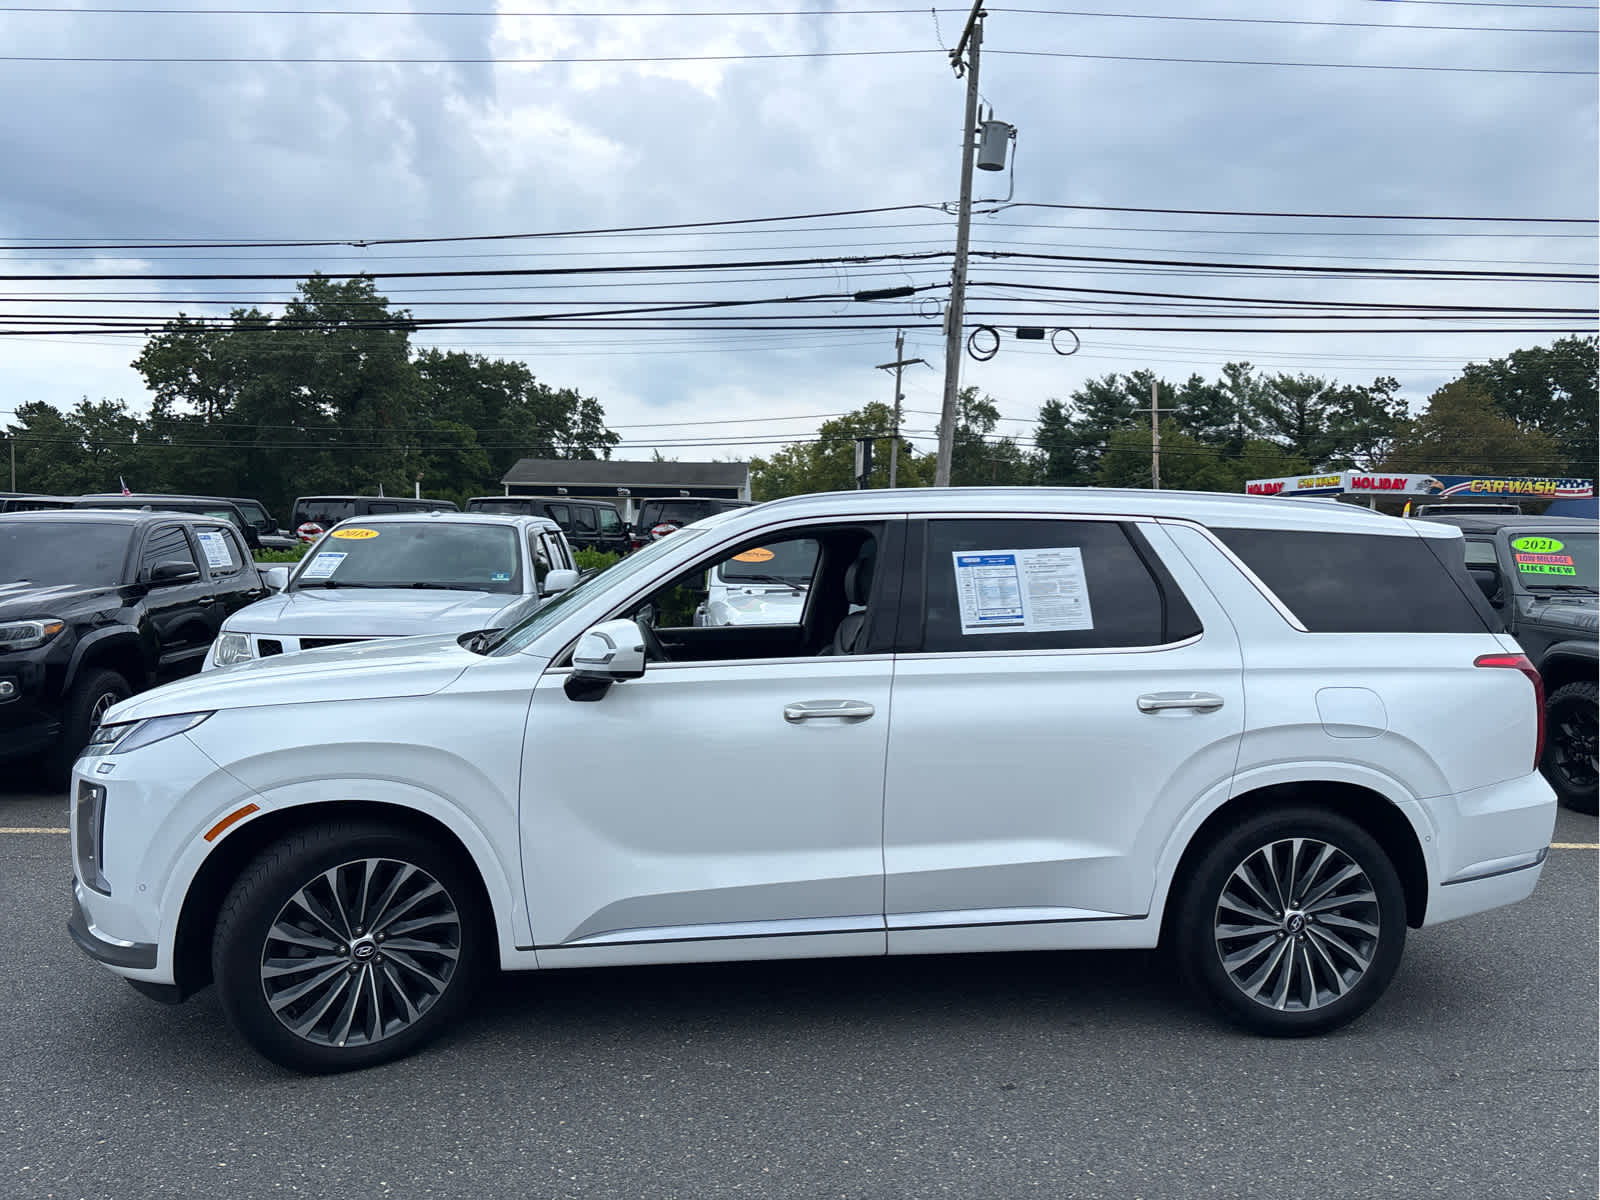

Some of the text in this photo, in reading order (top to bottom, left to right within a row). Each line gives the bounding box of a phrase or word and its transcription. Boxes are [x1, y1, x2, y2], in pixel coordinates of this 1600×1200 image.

[1247, 475, 1341, 495] HOLIDAY CAR WASH
[1351, 477, 1408, 490] HOLIDAY
[1522, 540, 1553, 550] 2021
[1519, 554, 1569, 564] LOW MILEAGE
[1520, 564, 1573, 574] LIKE NEW
